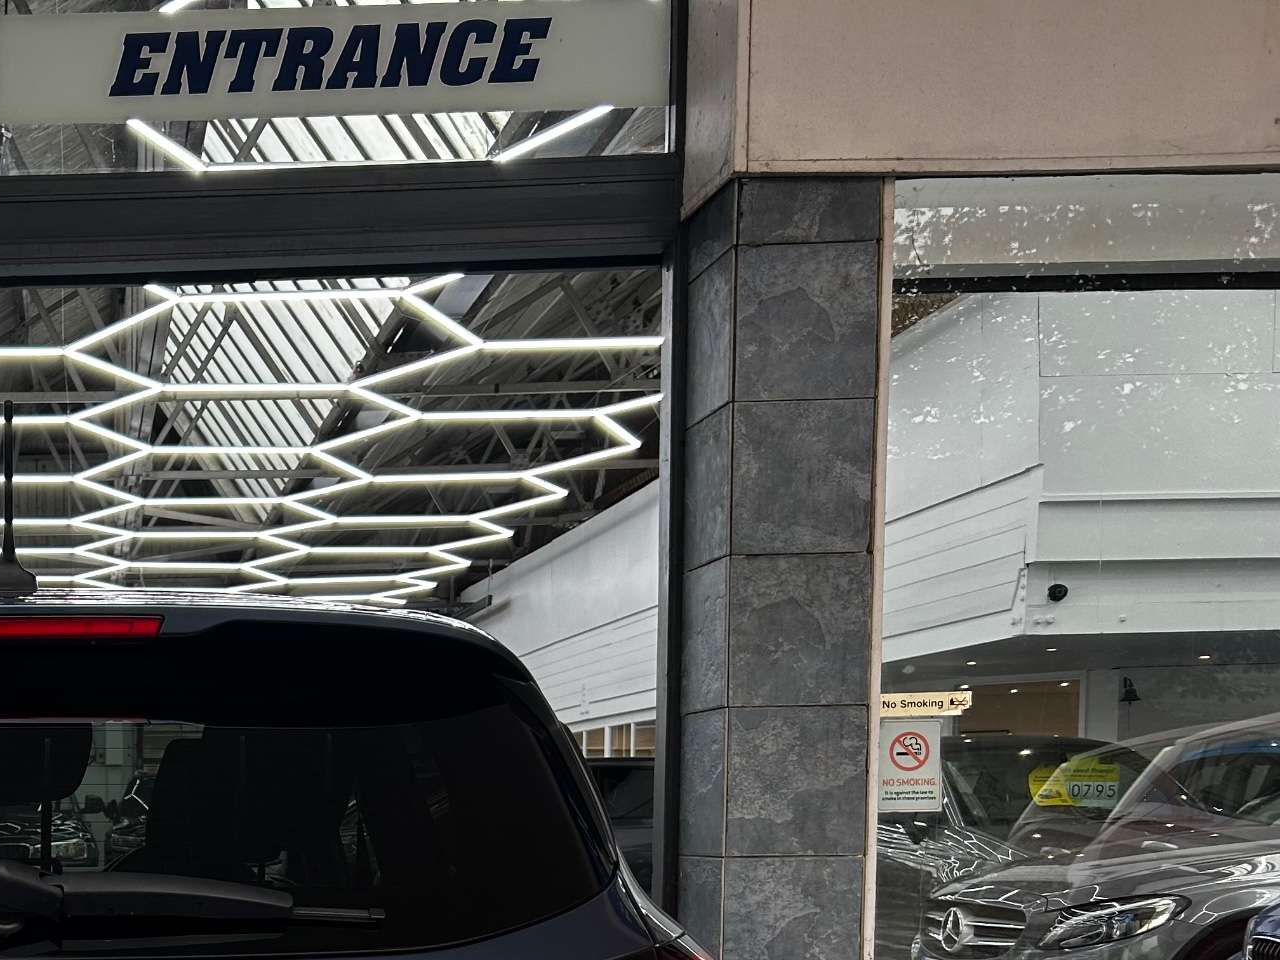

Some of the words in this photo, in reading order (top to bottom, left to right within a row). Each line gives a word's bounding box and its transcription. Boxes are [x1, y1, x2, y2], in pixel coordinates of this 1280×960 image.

[109, 17, 552, 97] ENTRANCE
[882, 700, 897, 709] No
[900, 698, 944, 710] Smoking
[882, 778, 895, 787] NO
